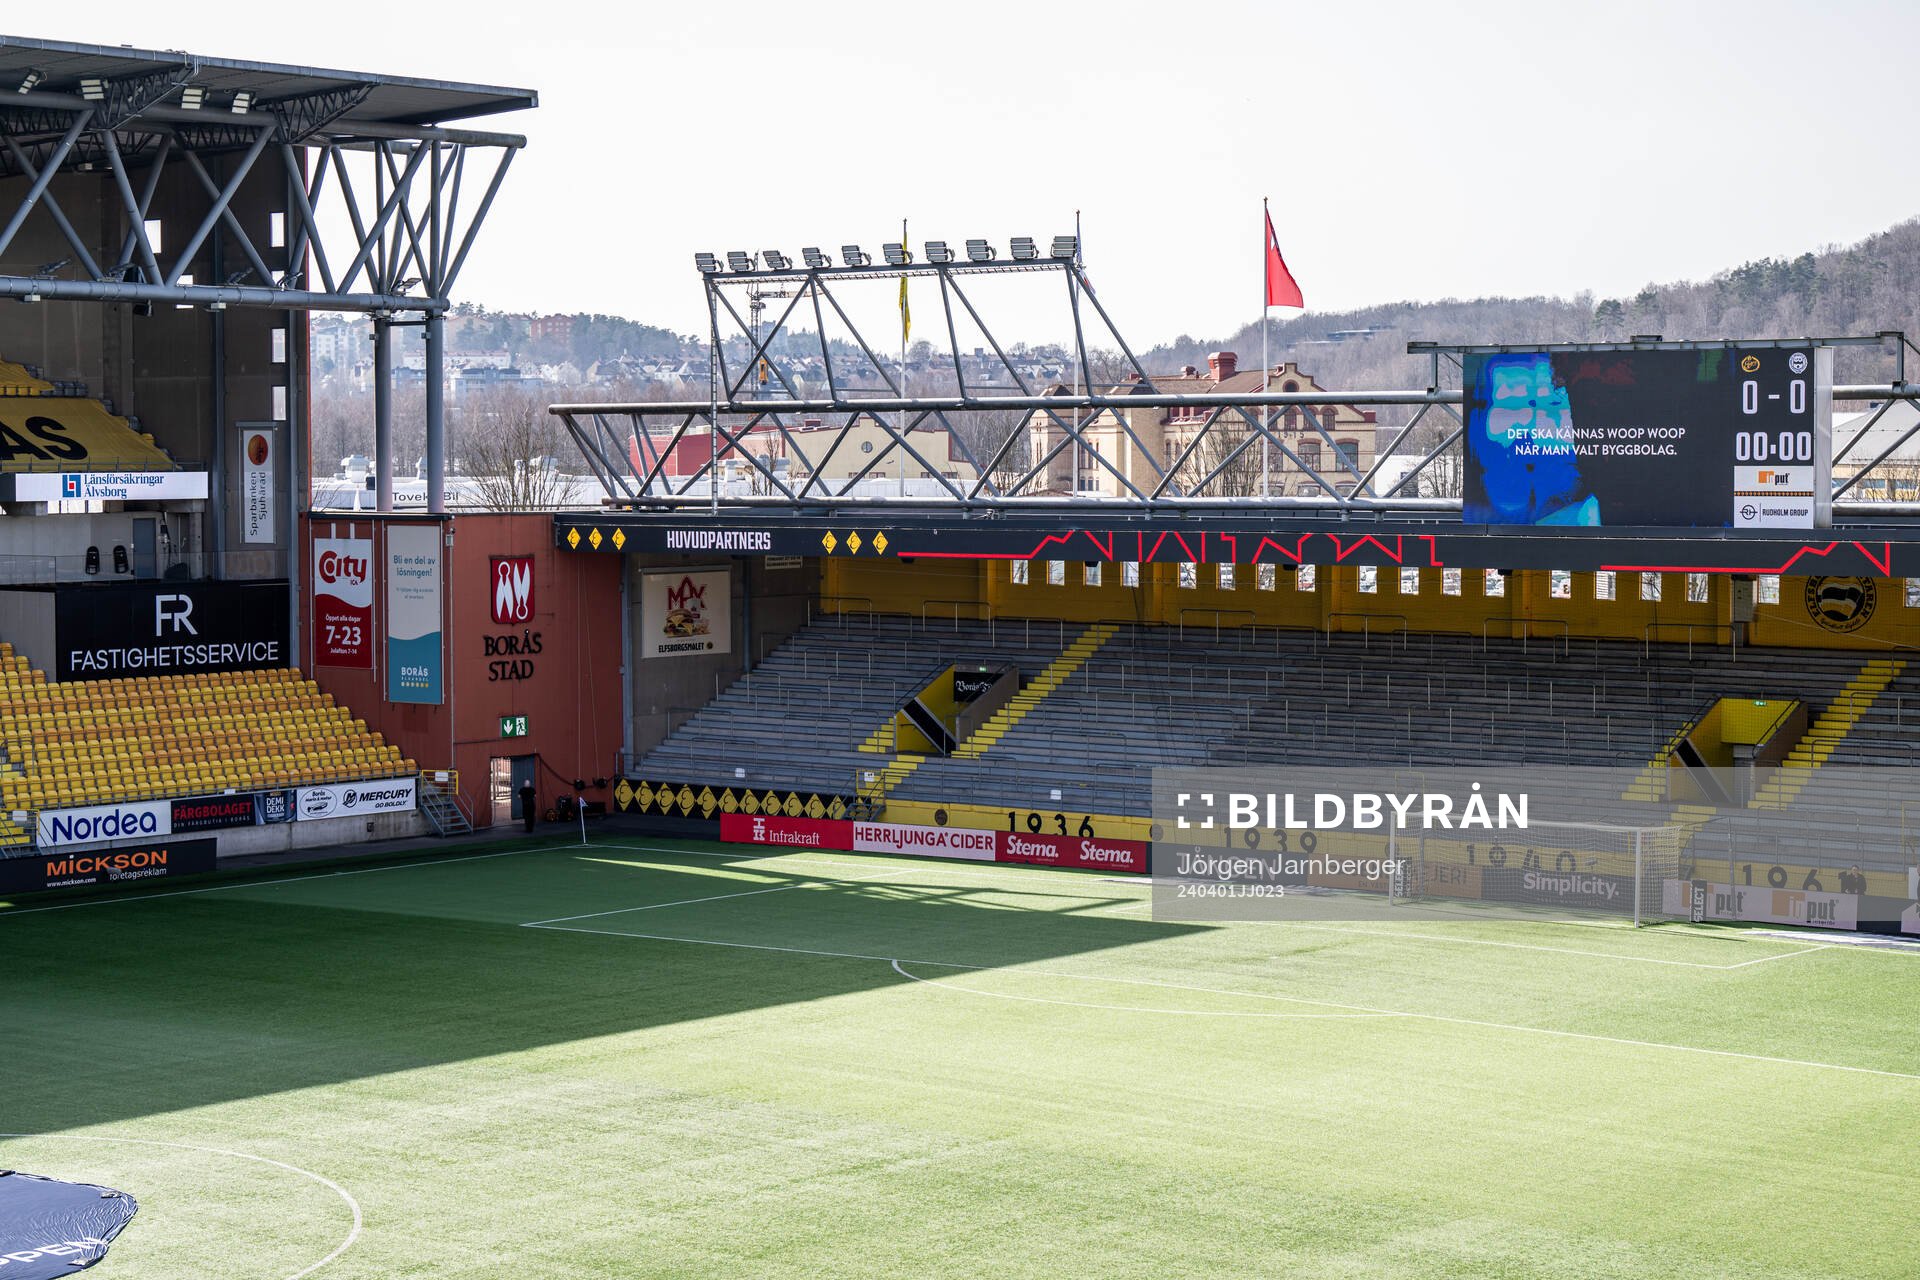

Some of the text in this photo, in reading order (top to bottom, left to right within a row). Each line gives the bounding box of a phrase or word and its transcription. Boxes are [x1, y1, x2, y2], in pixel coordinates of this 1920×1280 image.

[1742, 380, 1758, 415] 0
[1790, 379, 1806, 414] 0
[1507, 425, 1686, 439] DET SKA KÄNNAS WOOP WOOP
[1515, 442, 1678, 456] NÄR MAN VALT BYGGBOLAG.
[1736, 432, 1812, 461] 00:00
[84, 473, 165, 487] Länsförsäkringar
[84, 486, 128, 499] Älvsborg
[259, 472, 267, 520] Sjuhärad
[393, 492, 459, 501] Tovek Bil
[250, 472, 259, 536] Sparbanken
[1762, 508, 1808, 517] RUDHOLM GROUP
[667, 531, 771, 550] HUVUDPARTNERS
[318, 550, 368, 584] City
[393, 554, 403, 564] Bli
[414, 555, 426, 564] del
[396, 567, 432, 579] lösningen!
[156, 594, 198, 637] FR
[325, 614, 340, 622] Öppet
[325, 625, 362, 646] 7-23
[483, 629, 542, 656] BORÅS
[71, 641, 279, 671] FASTIGHETSSERVICE
[401, 665, 429, 677] BORÅS
[488, 660, 534, 681] STAD
[266, 797, 284, 806] DEMI
[359, 788, 412, 802] MERCURY
[173, 802, 252, 821] FÄRGBOLAGET
[266, 804, 284, 814] DEKK
[52, 809, 157, 842] Nordea
[1008, 811, 1094, 838] 1936
[769, 830, 820, 845] Infrakraft
[855, 827, 993, 850] HERRLJUNGA CIDER
[47, 877, 97, 887] www.mickson.com
[1694, 887, 1704, 922] SELECT
